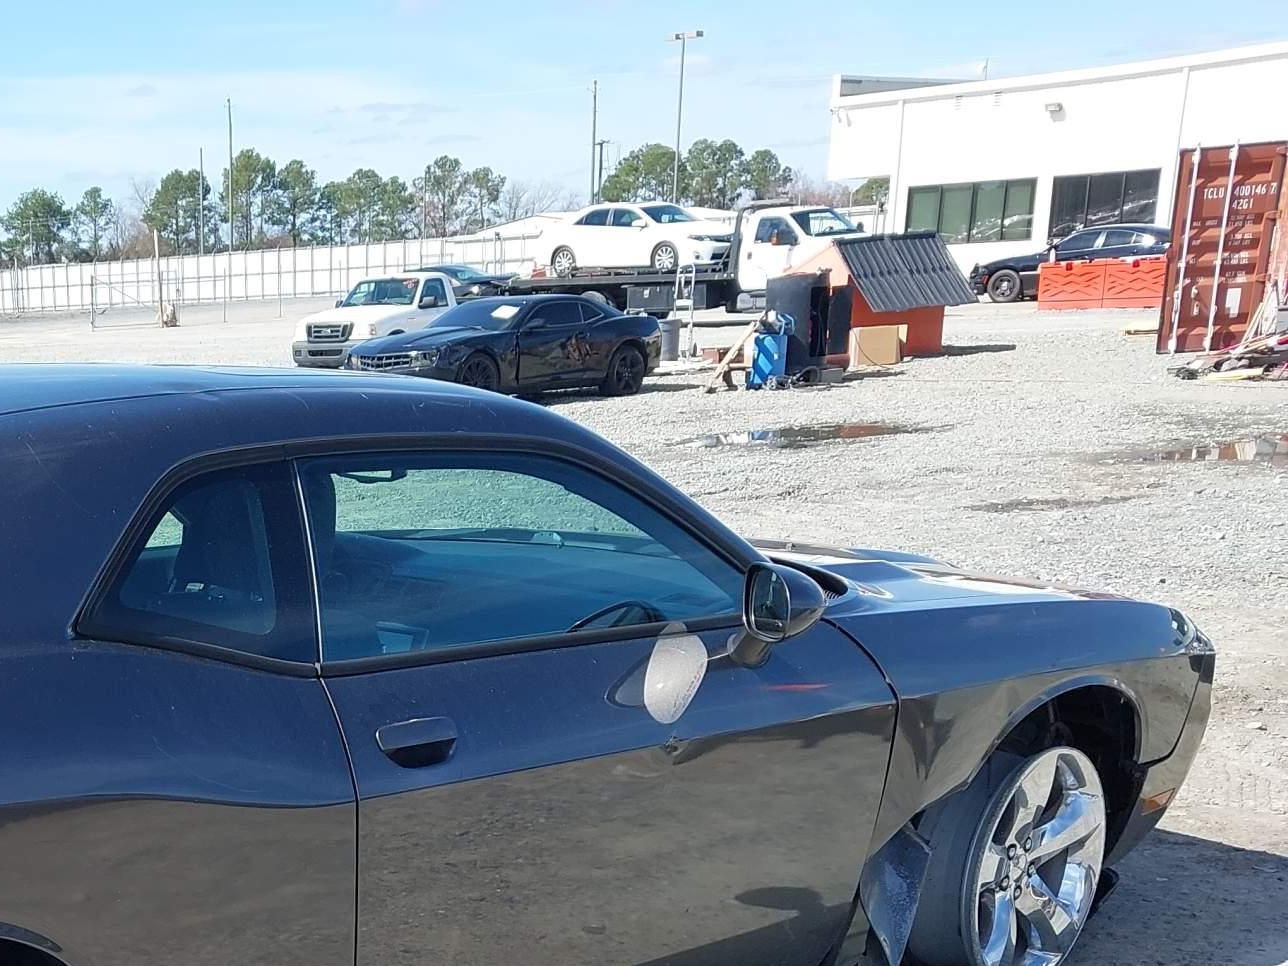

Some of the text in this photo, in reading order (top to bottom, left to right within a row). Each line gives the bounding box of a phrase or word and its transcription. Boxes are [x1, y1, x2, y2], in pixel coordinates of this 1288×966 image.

[1203, 187, 1224, 199] TCLU
[1234, 184, 1266, 196] 400146
[1232, 199, 1253, 209] 42G1
